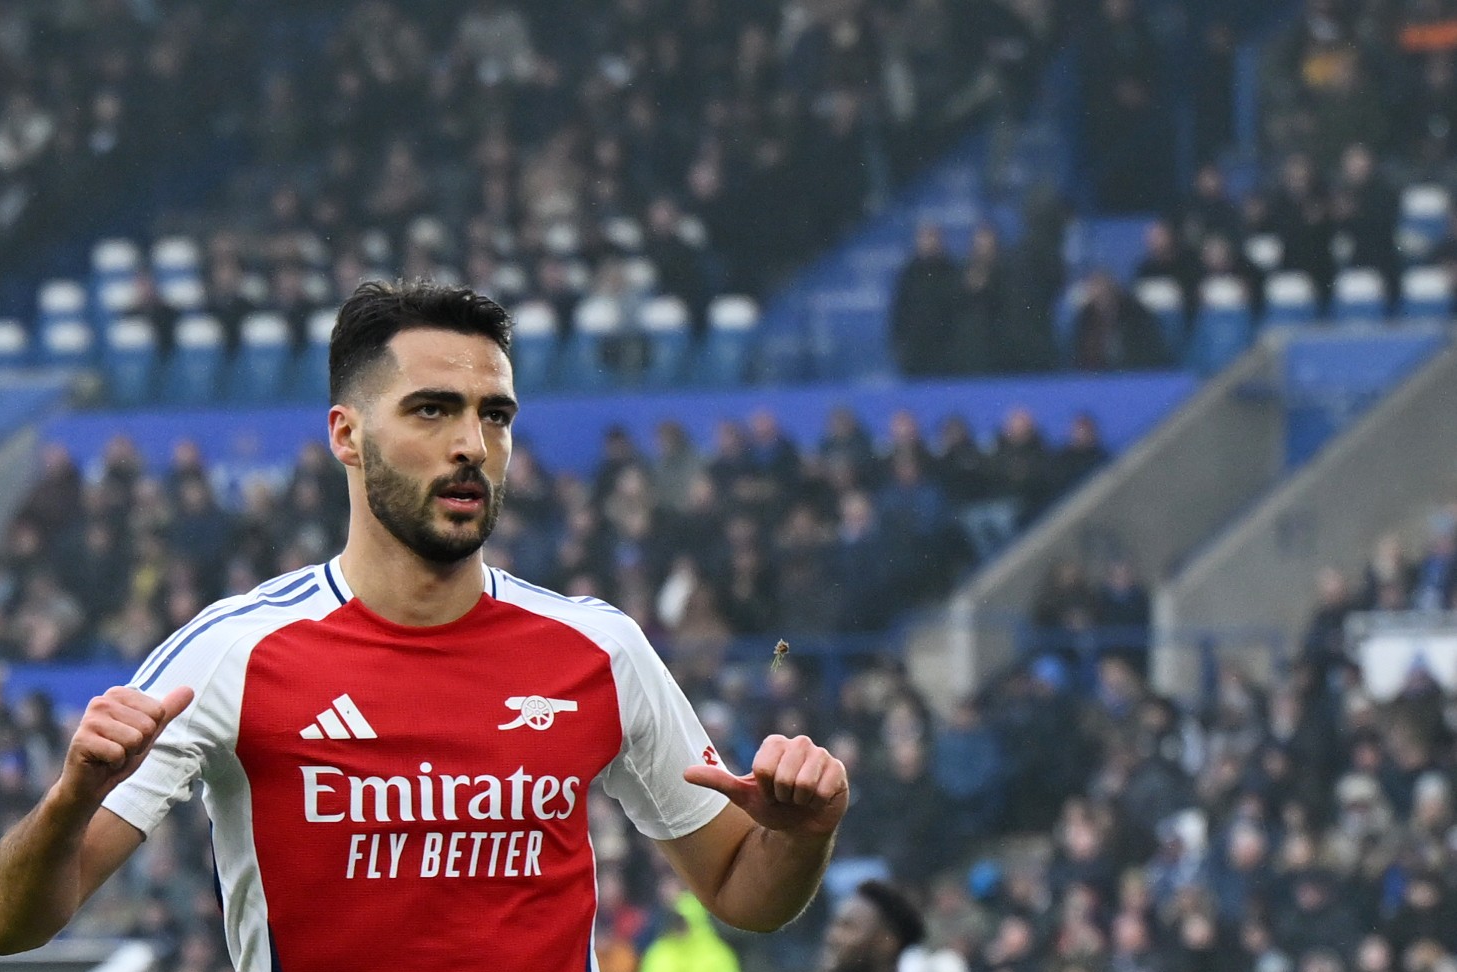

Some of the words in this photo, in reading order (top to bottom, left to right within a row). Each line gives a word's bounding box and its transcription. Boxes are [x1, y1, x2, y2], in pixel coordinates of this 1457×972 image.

[298, 761, 581, 823] Emirates
[345, 833, 408, 879] FLY
[420, 830, 543, 878] BETTER
